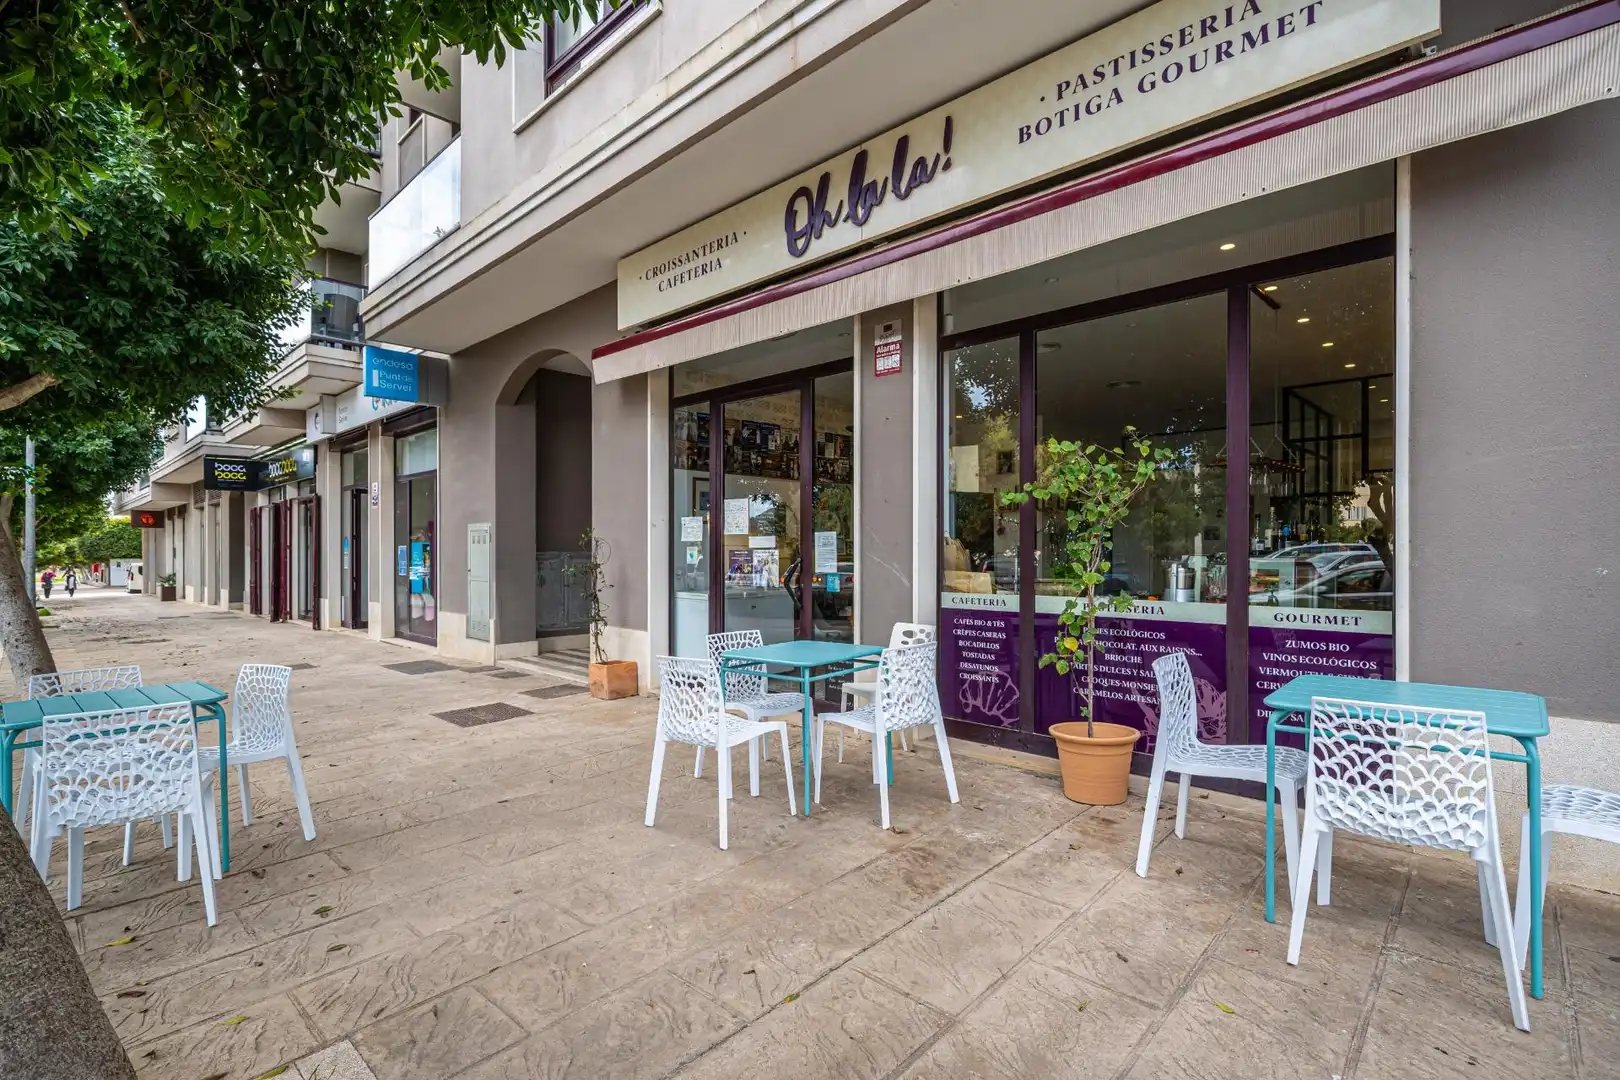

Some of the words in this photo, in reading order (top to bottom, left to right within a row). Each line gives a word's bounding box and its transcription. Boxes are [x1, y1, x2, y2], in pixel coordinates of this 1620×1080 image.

[1056, 0, 1263, 101] PASTISSERIA
[1017, 86, 1124, 145] BOTIGA
[1137, 1, 1323, 94] GOURMET
[785, 171, 843, 257] Oh
[843, 149, 888, 227] la
[891, 115, 953, 201] la!
[645, 231, 739, 281] CROISSANTERIA
[658, 258, 722, 292] CAFETERIA
[876, 343, 900, 354] Alarma
[372, 357, 414, 371] endesa
[379, 370, 401, 381] Punt
[401, 374, 413, 382] de
[379, 380, 412, 392] Servei
[215, 462, 247, 473] boca
[215, 470, 247, 481] boca
[974, 618, 986, 626] BIO
[986, 619, 992, 627] &
[1273, 612, 1363, 627] GOURMET
[976, 630, 1007, 640] CASERAS
[1083, 626, 1109, 636] PNES
[1109, 628, 1166, 640] ECOLÓGICOS
[958, 639, 1000, 650] BOCADILLOS
[1139, 643, 1158, 653] AUX
[1285, 639, 1327, 651] ZUMOS
[1328, 642, 1350, 652] BIO
[961, 651, 996, 660] TOSTADAS
[1104, 653, 1143, 664] BRIOCHE
[1262, 652, 1298, 663] VINOS
[1299, 655, 1377, 670] ECOLÓGICOS
[959, 661, 999, 672] DESAYUNOS
[1070, 661, 1099, 672] TARTS
[1099, 664, 1131, 676] DULCES
[1132, 668, 1139, 676] Y
[1139, 669, 1156, 679] SAL
[959, 672, 1000, 683] CROISSANTS
